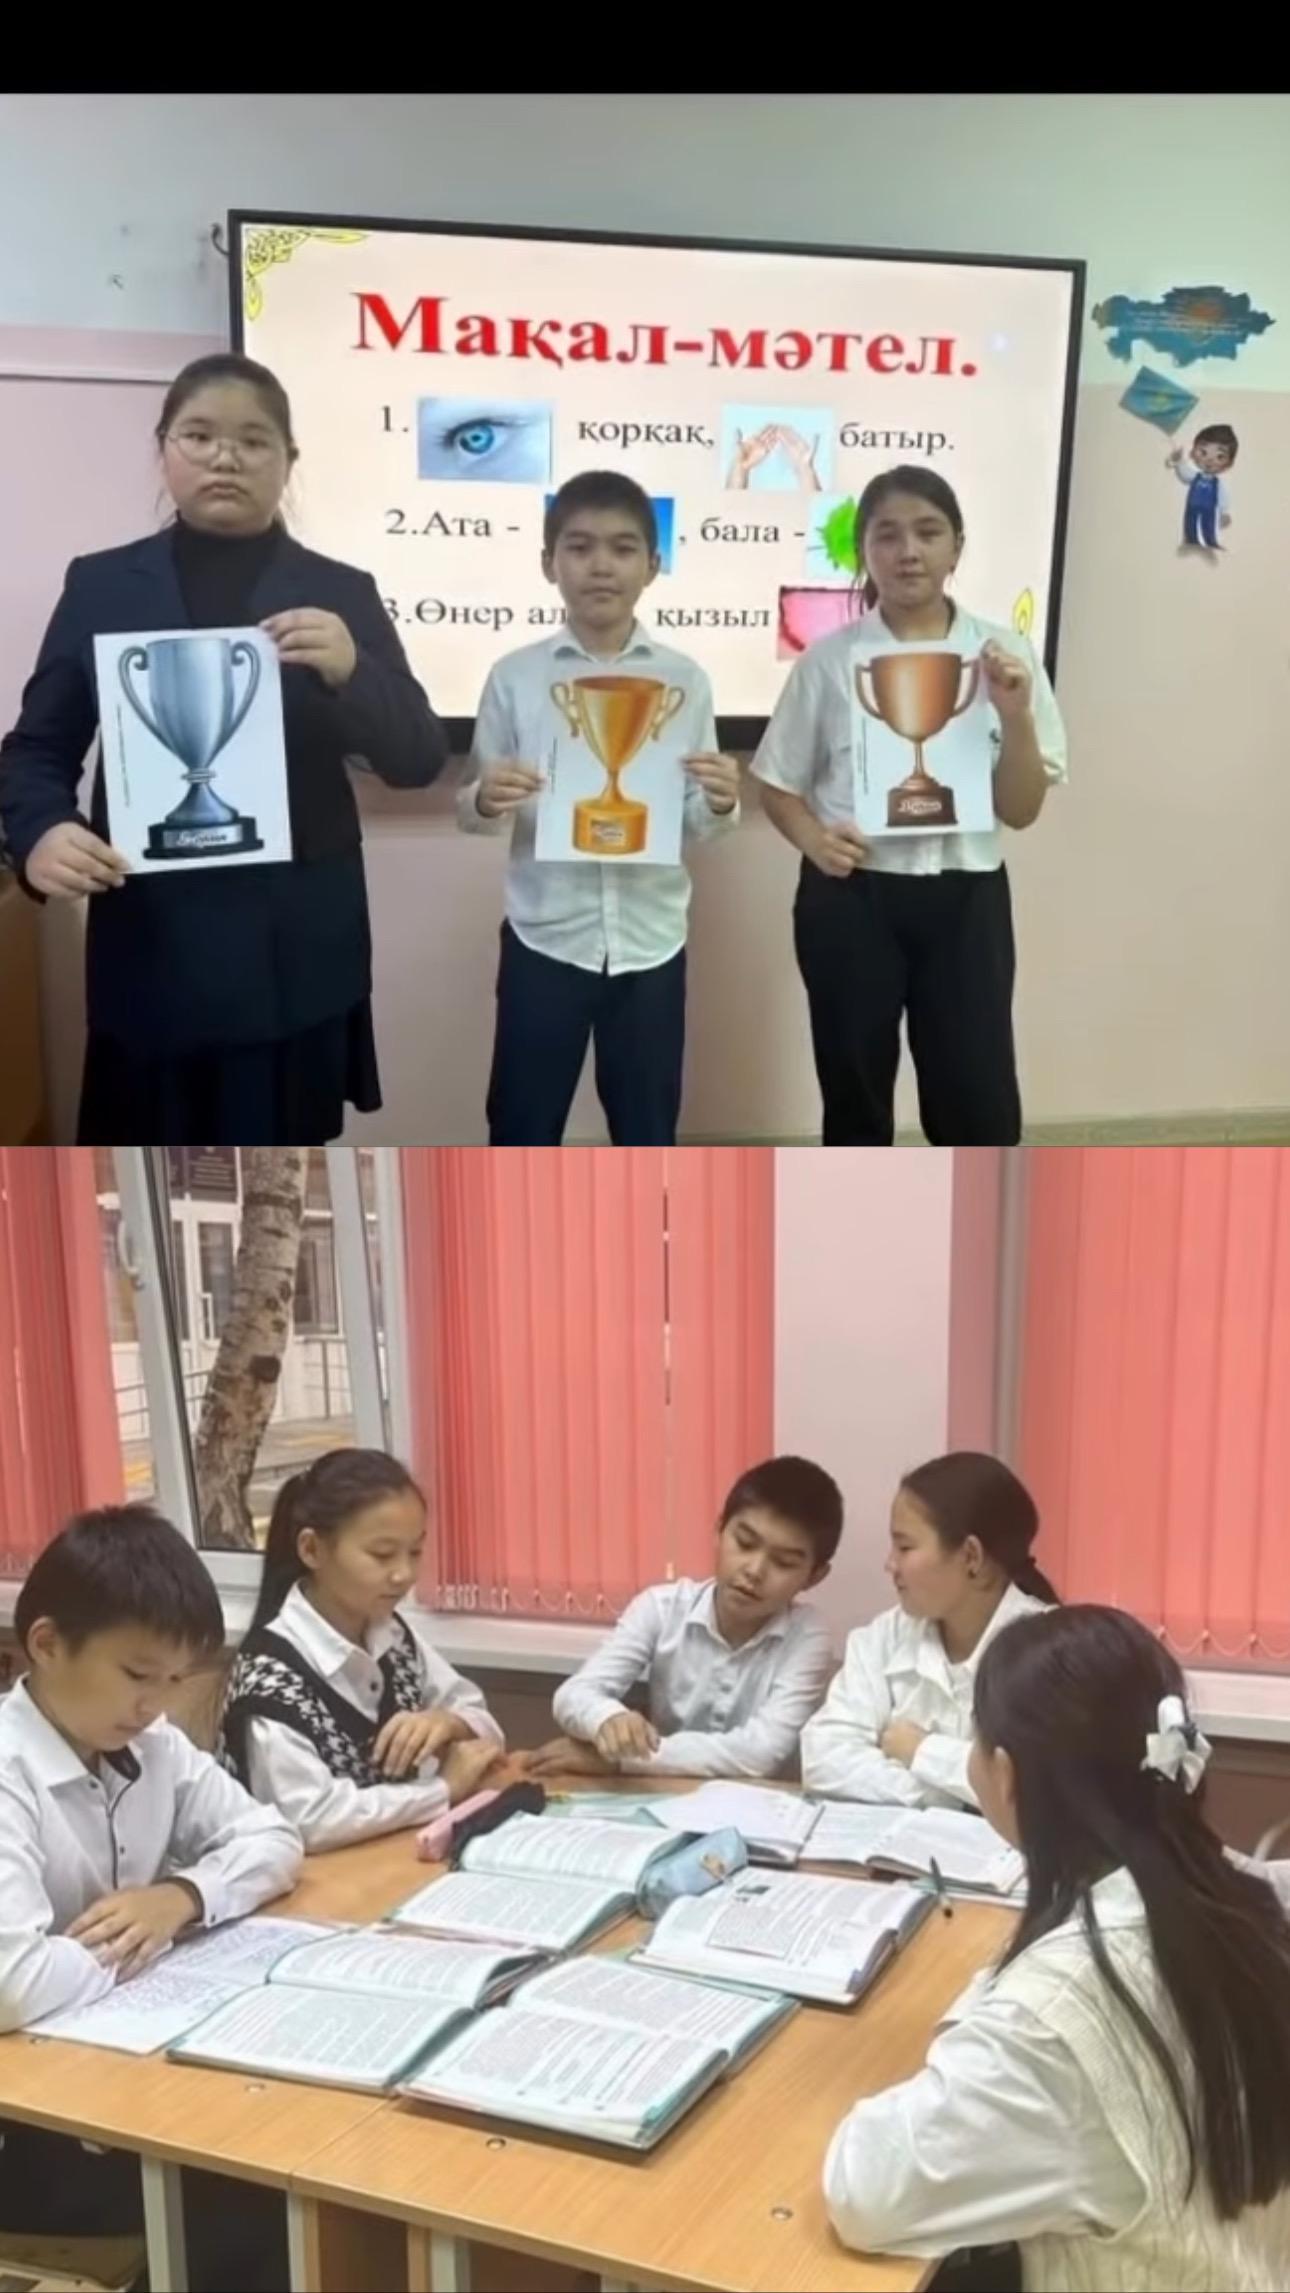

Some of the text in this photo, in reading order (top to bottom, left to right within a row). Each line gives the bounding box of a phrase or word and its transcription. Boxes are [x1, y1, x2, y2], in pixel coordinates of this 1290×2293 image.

[350, 292, 978, 377] Мақал-мәтел.
[382, 405, 410, 433] 1.
[839, 421, 956, 456] батыр.
[700, 516, 781, 543] бала
[655, 607, 772, 630] қызыл
